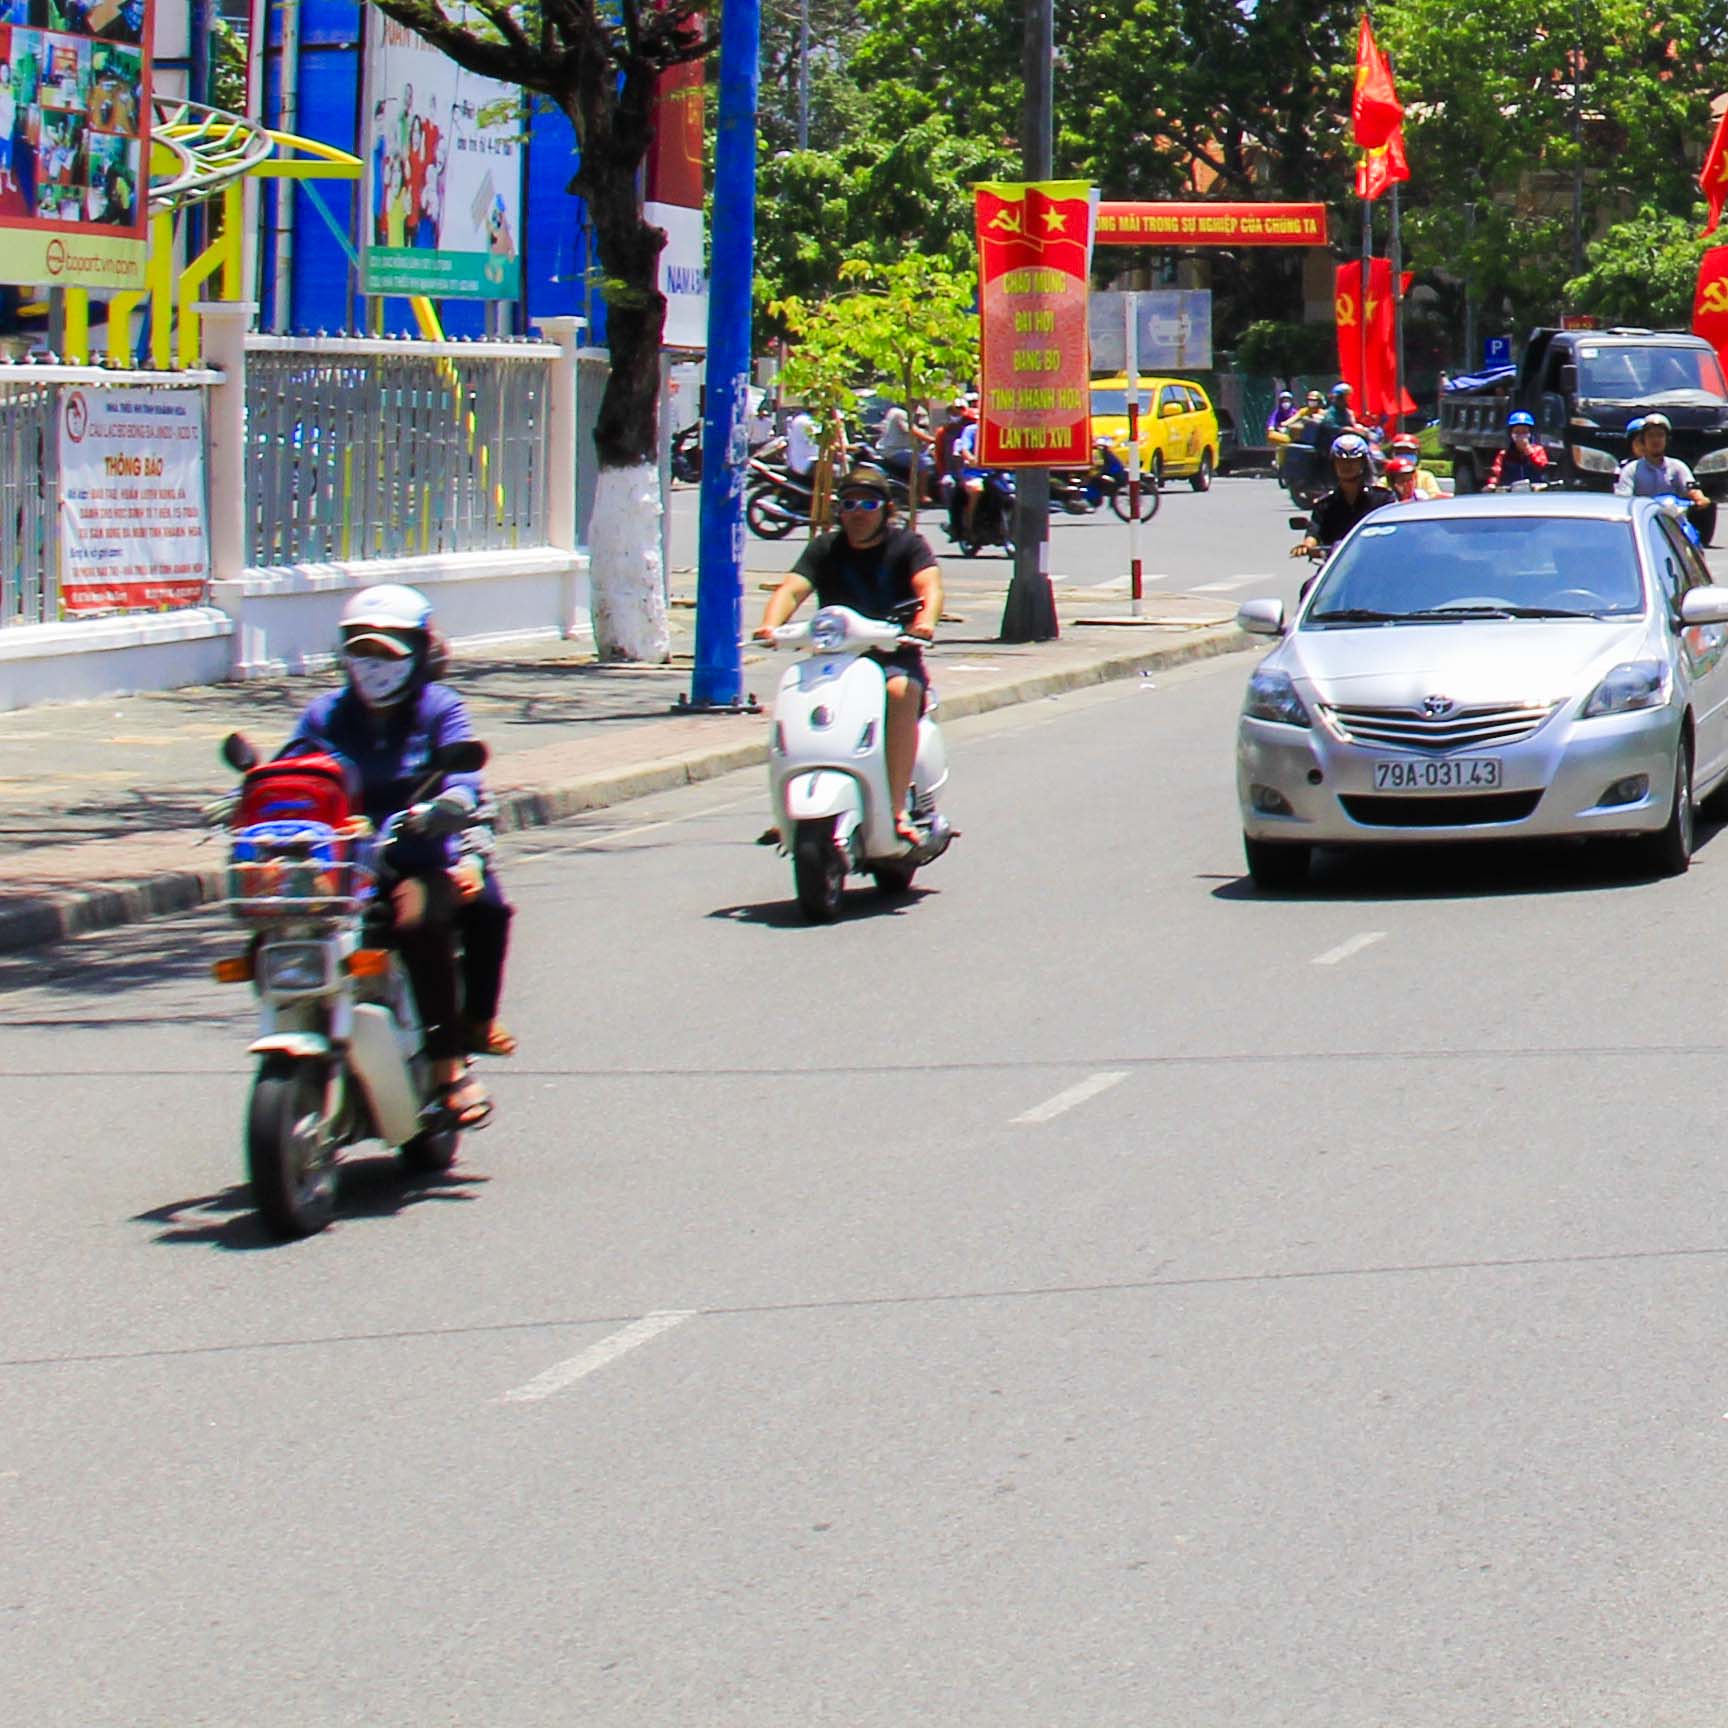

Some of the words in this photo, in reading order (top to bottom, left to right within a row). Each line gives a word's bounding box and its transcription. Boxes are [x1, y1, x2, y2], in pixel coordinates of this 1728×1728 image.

[1142, 216, 1179, 232] TRONG
[1240, 214, 1263, 233] CỦA
[1303, 218, 1318, 233] TA
[105, 452, 141, 476] THÔNG
[1378, 761, 1497, 787] 79A-031.43
